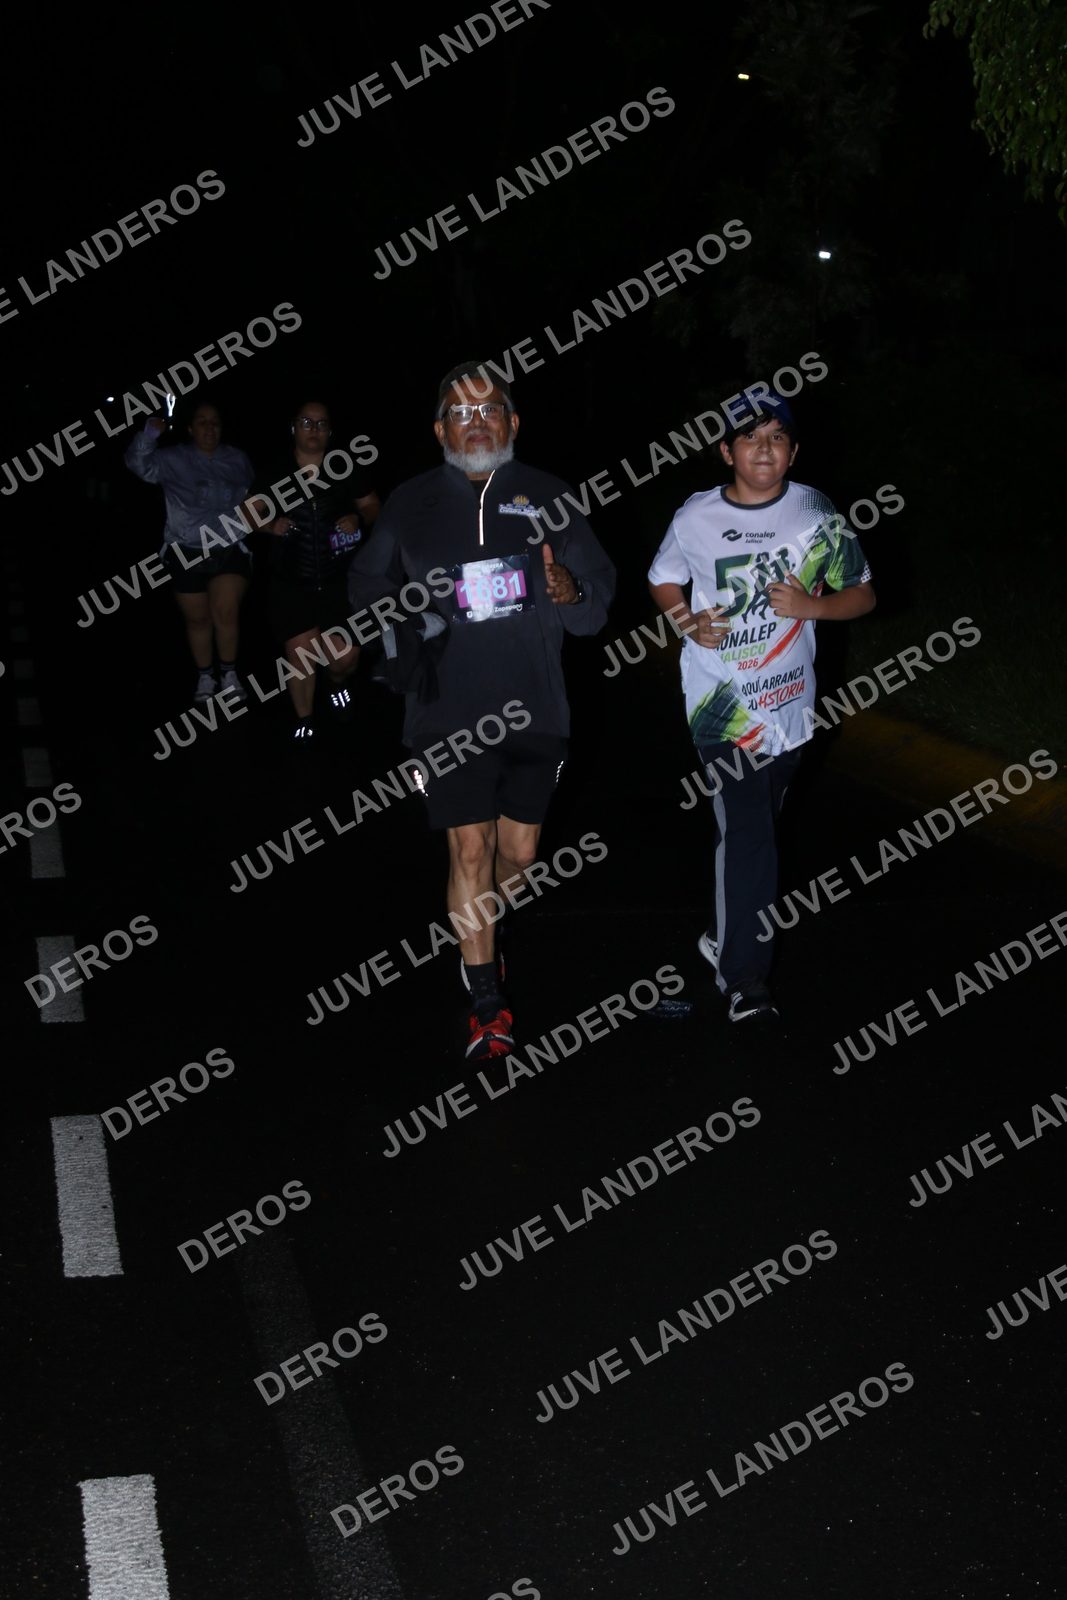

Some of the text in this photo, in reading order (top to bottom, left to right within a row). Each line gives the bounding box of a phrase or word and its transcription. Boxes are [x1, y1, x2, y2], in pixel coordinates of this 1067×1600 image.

[745, 531, 776, 541] conalep
[459, 572, 522, 605] 1681
[737, 657, 759, 671] 2026
[761, 665, 804, 690] ARRANCA
